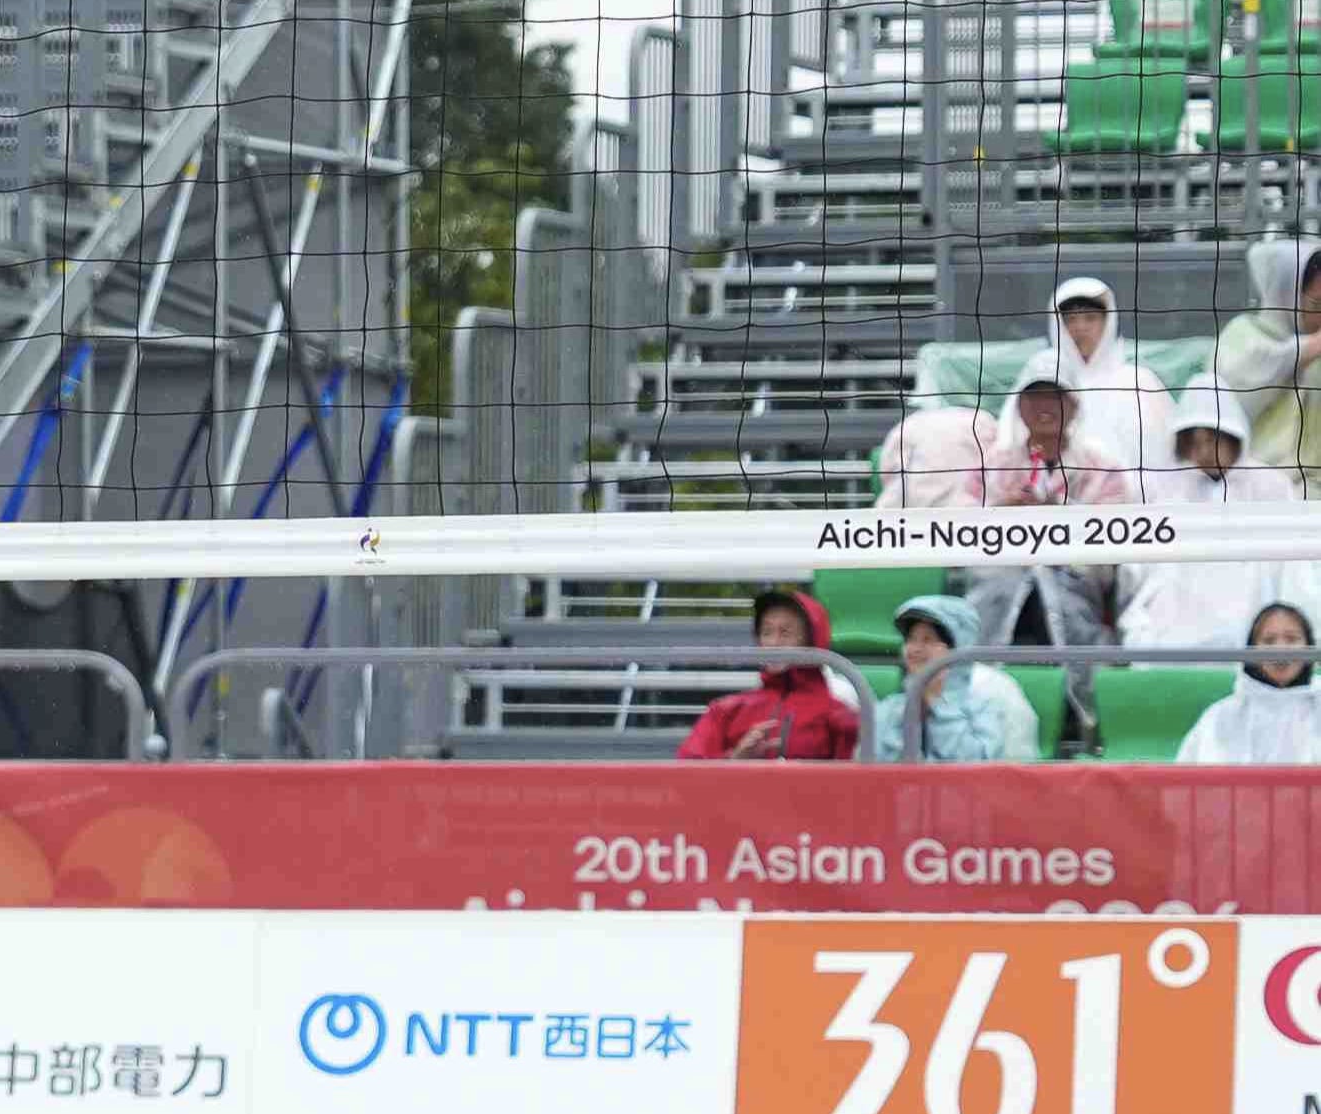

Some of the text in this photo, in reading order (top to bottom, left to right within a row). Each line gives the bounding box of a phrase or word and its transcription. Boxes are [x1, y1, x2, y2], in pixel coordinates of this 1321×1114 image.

[817, 516, 1177, 556] Aichi-Nagoya 2026
[573, 833, 1115, 885] 20th Asian Games
